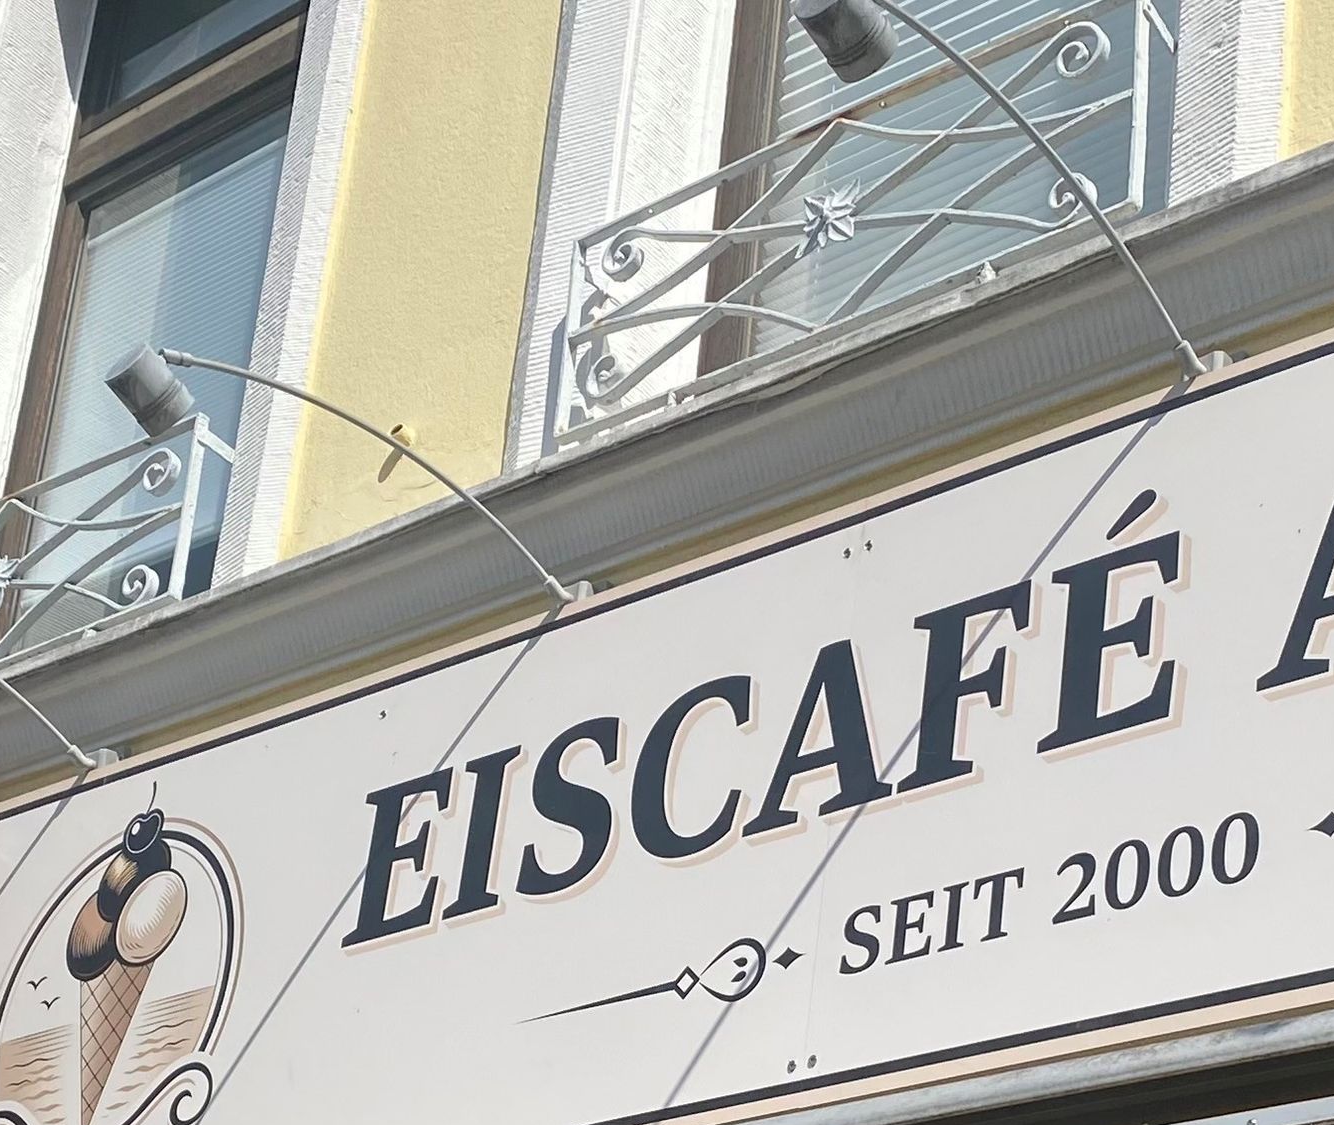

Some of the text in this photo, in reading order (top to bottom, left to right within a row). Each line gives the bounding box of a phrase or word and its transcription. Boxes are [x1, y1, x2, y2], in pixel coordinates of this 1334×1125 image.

[340, 488, 1183, 949] EISCAFÉ
[838, 811, 1261, 975] SEIT 2000
